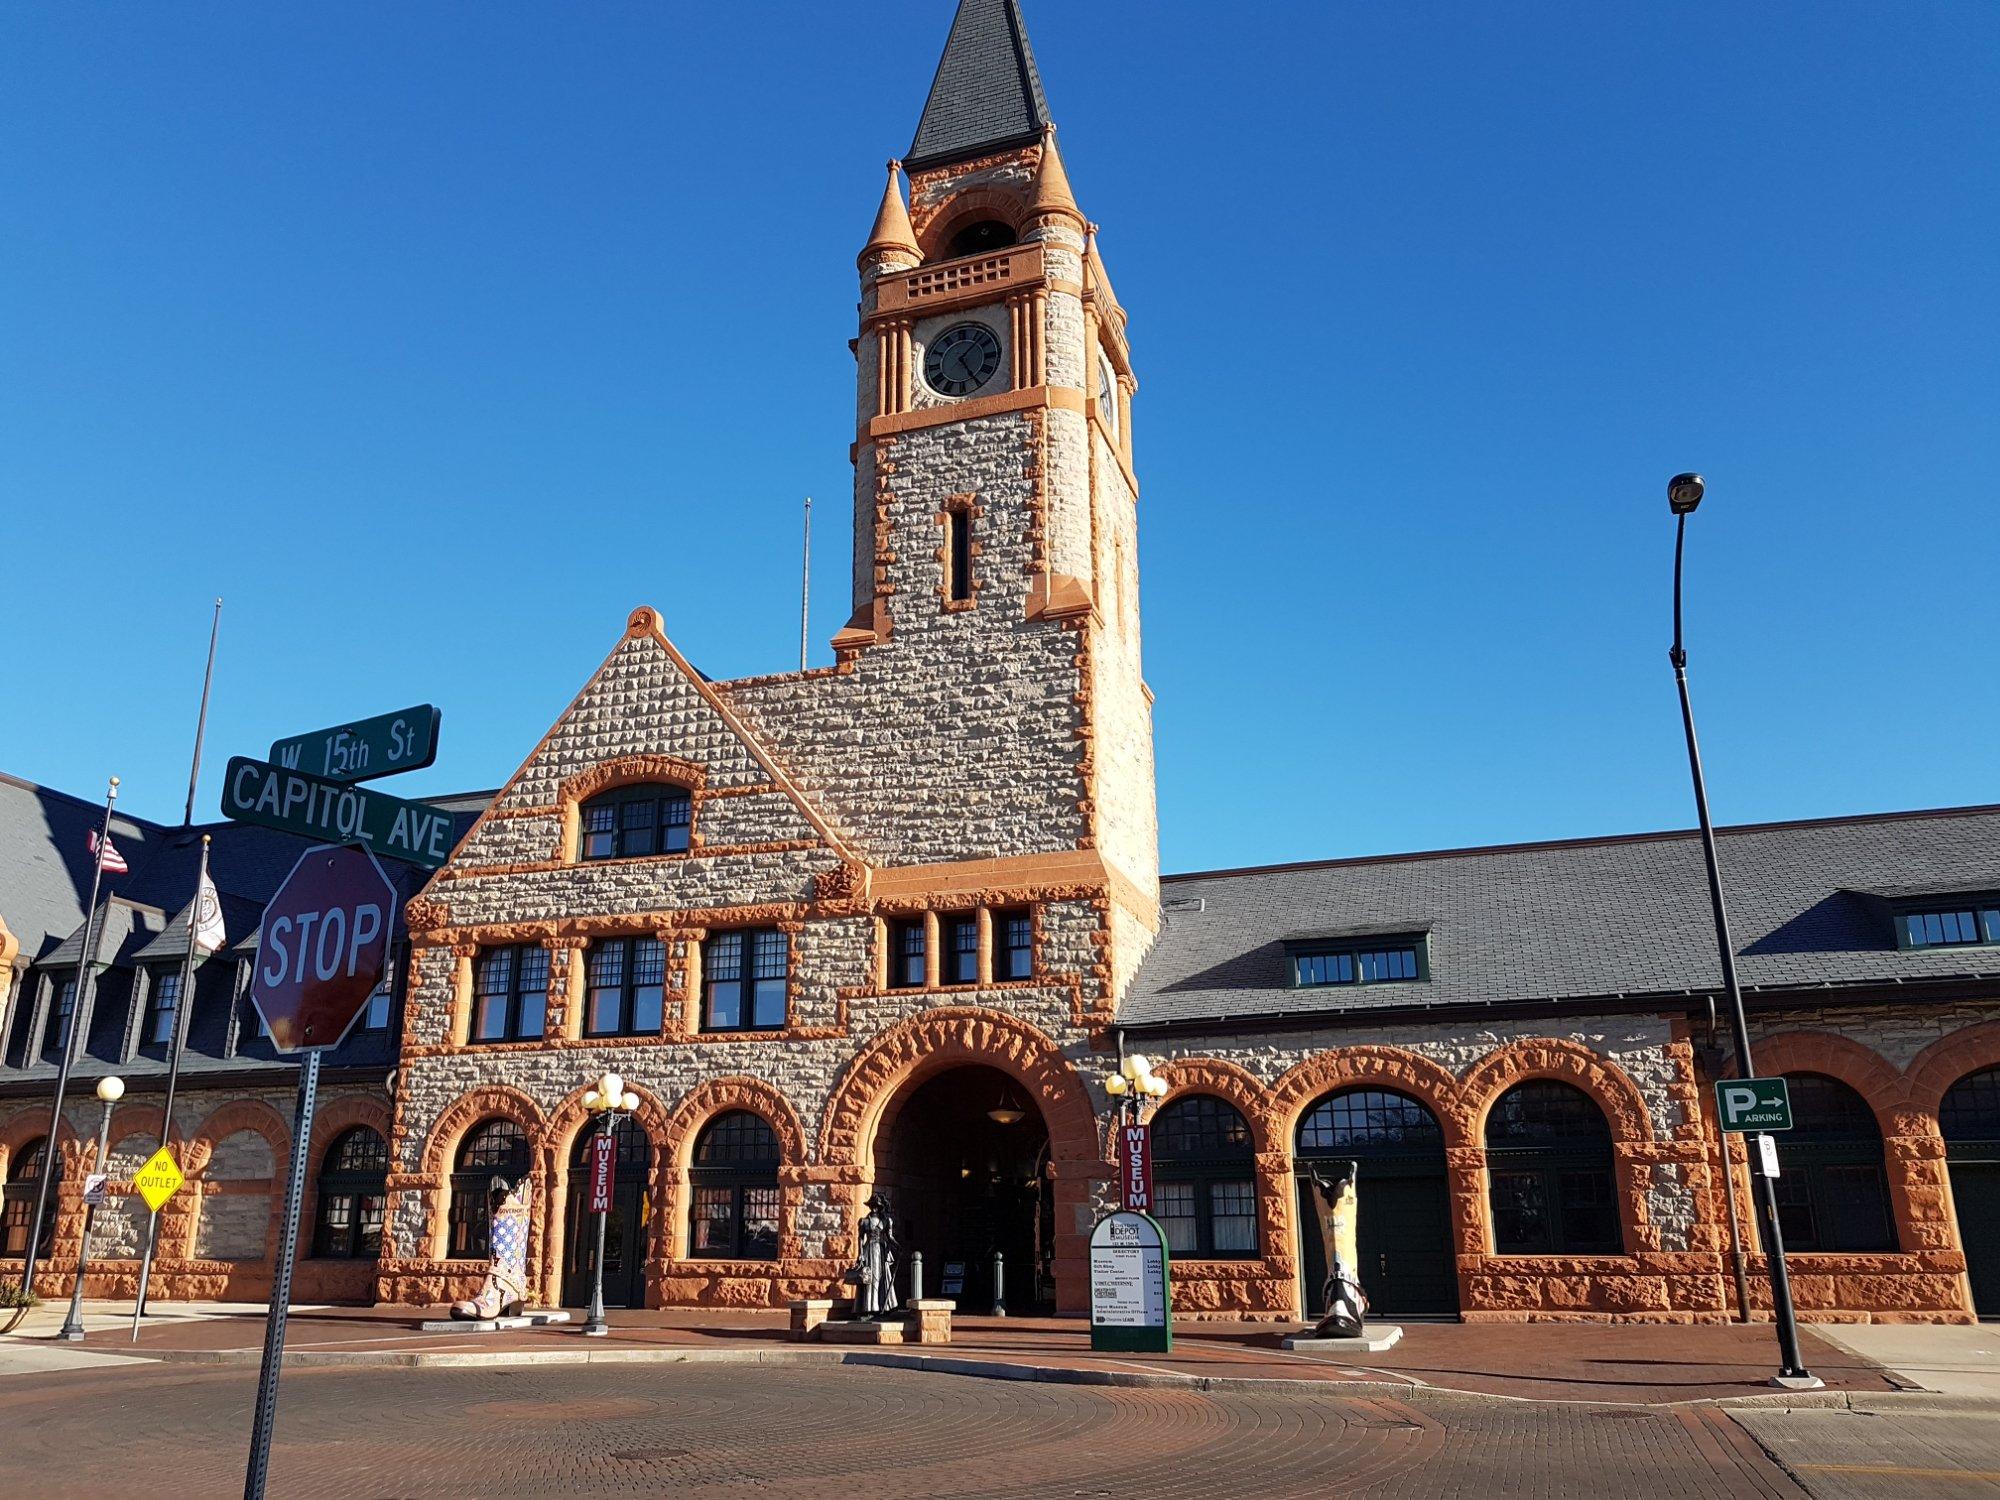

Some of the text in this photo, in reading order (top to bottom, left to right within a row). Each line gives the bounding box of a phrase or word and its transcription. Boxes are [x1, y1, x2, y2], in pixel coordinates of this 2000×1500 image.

[281, 718, 416, 777] W 15th St
[232, 764, 450, 859] CAPITOL AVE
[263, 903, 382, 988] STOP
[140, 1176, 177, 1189] OUTLET
[154, 1161, 168, 1172] NO
[593, 1138, 612, 1210] MUSEUM
[1126, 1128, 1147, 1207] MUSEUM
